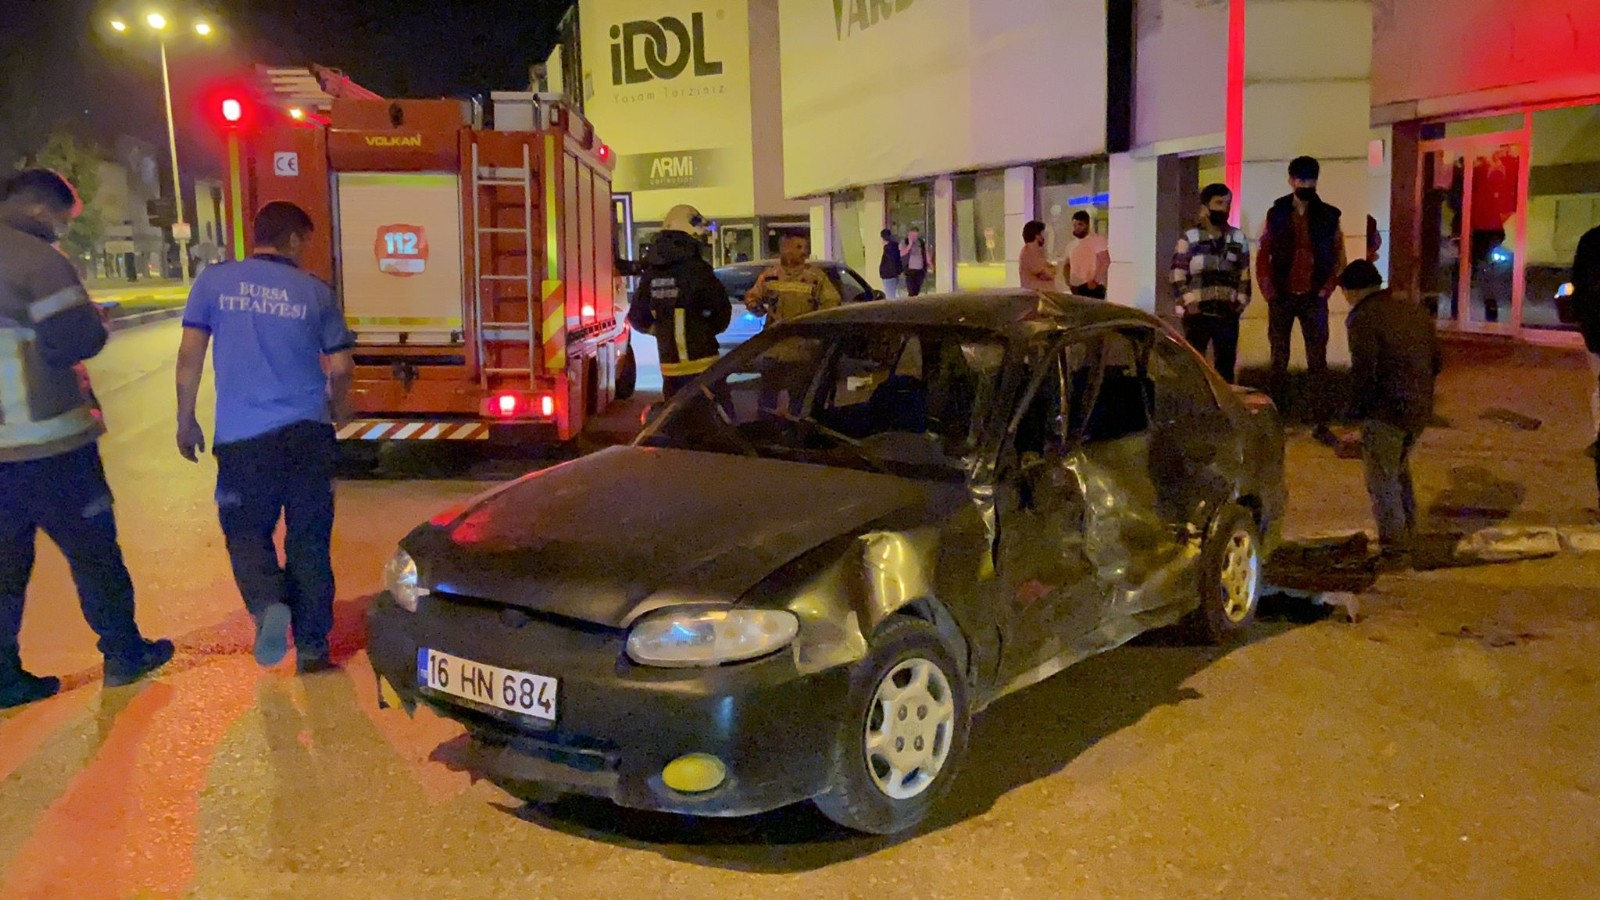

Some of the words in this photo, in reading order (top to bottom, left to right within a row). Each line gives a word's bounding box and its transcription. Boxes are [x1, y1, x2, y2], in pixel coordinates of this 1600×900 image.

[365, 134, 421, 146] VOLKAN
[384, 231, 418, 254] 112
[240, 281, 289, 302] BURSA
[430, 655, 449, 687] 16
[461, 663, 494, 701] HN
[503, 674, 552, 713] 684
